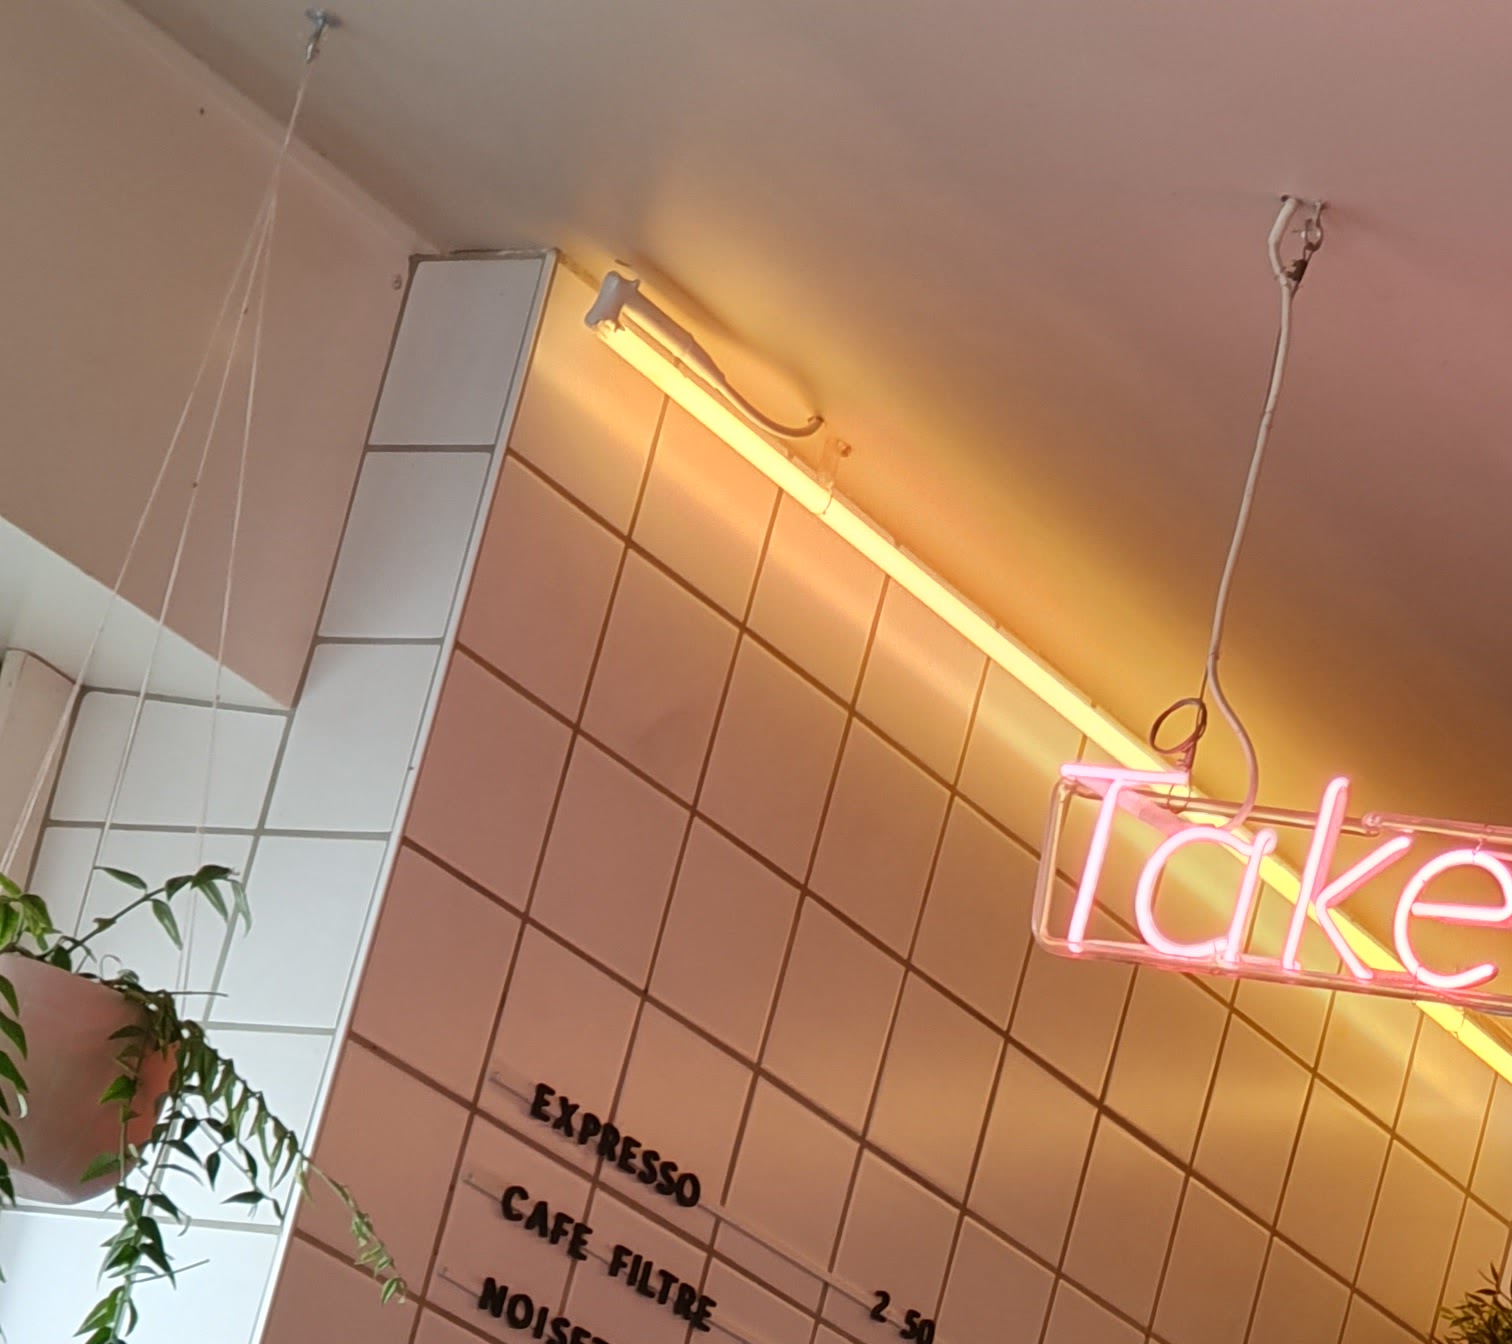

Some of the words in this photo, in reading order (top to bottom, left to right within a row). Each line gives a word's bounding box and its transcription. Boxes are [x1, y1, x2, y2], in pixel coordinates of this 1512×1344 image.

[530, 1082, 701, 1207] EXPRESSO
[500, 1184, 591, 1262] CAFE
[609, 1243, 717, 1333] FILTRE
